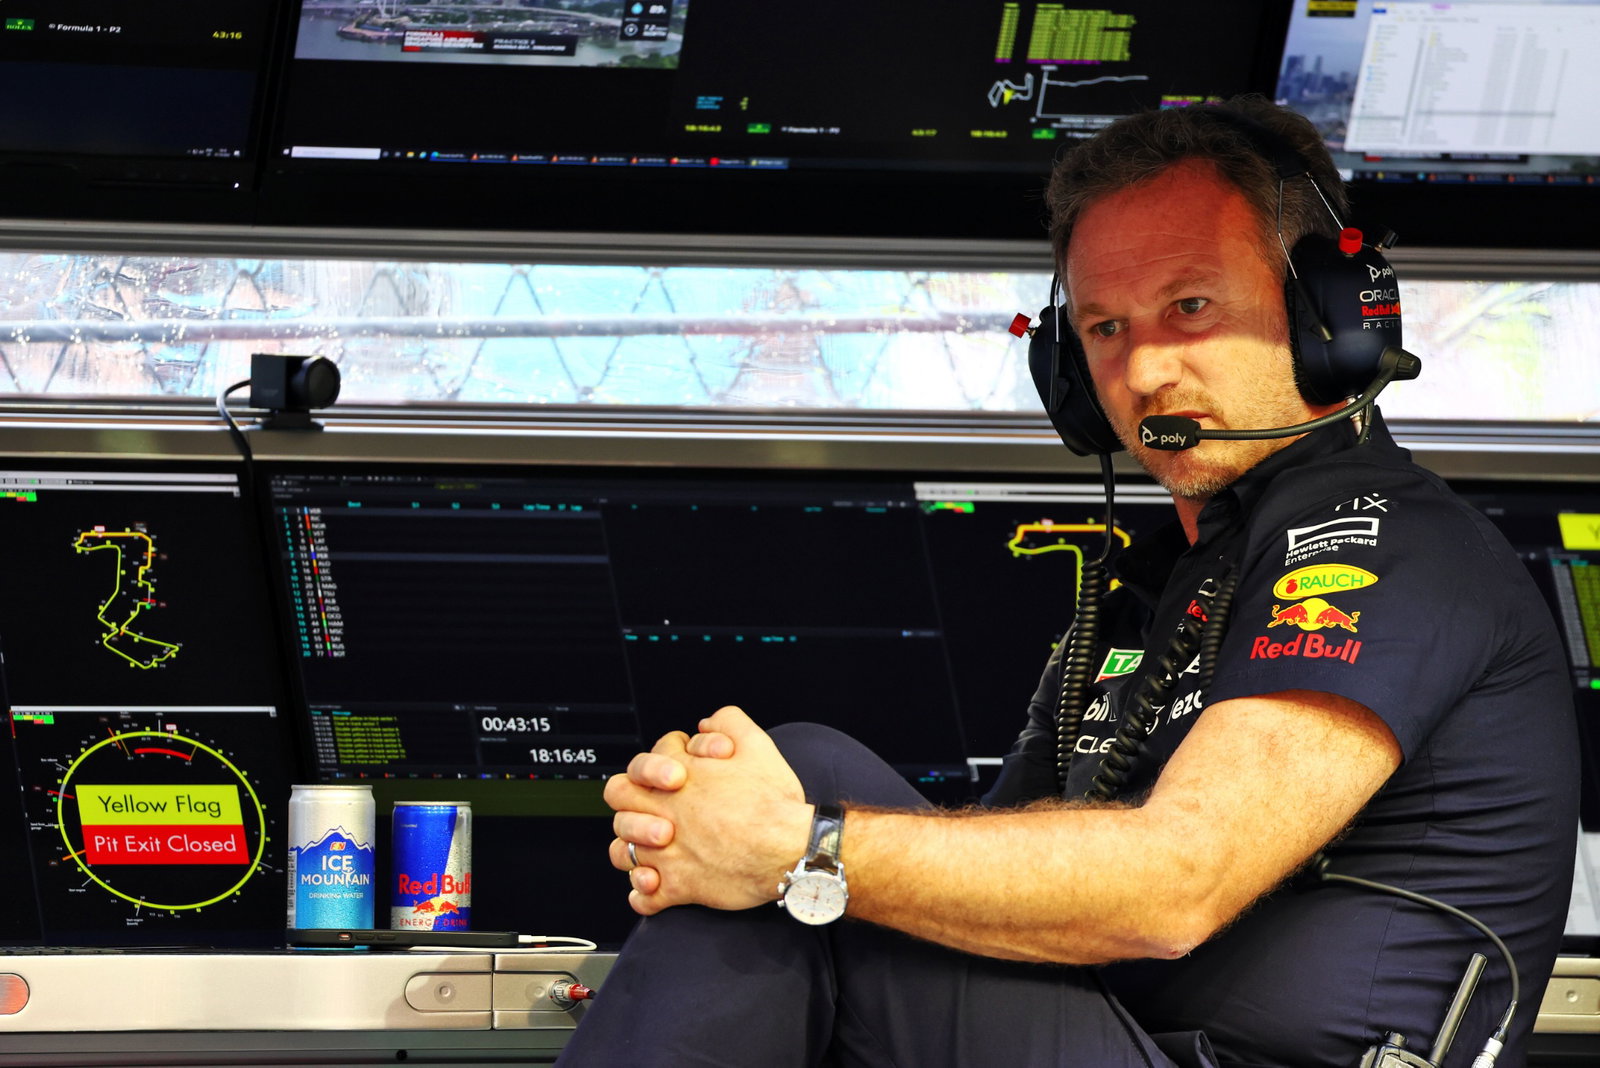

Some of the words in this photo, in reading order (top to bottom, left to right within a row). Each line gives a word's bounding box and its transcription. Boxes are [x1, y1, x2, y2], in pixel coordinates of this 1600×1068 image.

[57, 24, 93, 32] Formula
[212, 31, 242, 39] 43:16
[1382, 265, 1394, 279] poly
[1363, 321, 1395, 330] RACI
[1161, 432, 1187, 447] poly
[1284, 544, 1340, 567] Enterprise
[1286, 540, 1328, 560] Hewlett
[1330, 536, 1377, 547] Packard
[1300, 573, 1364, 591] RAUCH
[1250, 632, 1304, 660] Red
[1303, 633, 1363, 665] Bull
[1113, 654, 1144, 672] TA
[1082, 692, 1110, 721] bil
[481, 717, 551, 731] 00:43:15
[1074, 735, 1117, 754] CLE
[529, 749, 597, 763] 18:16:45
[98, 795, 167, 813] Yellow
[176, 795, 222, 818] Flag
[94, 835, 118, 852] Pit
[125, 835, 161, 852] Exit
[167, 834, 236, 852] Closed
[321, 855, 353, 871] ICE
[301, 873, 370, 887] MOUNTAIN
[399, 873, 438, 895] Red
[441, 872, 472, 895] Bull
[399, 918, 439, 927] ENERGY
